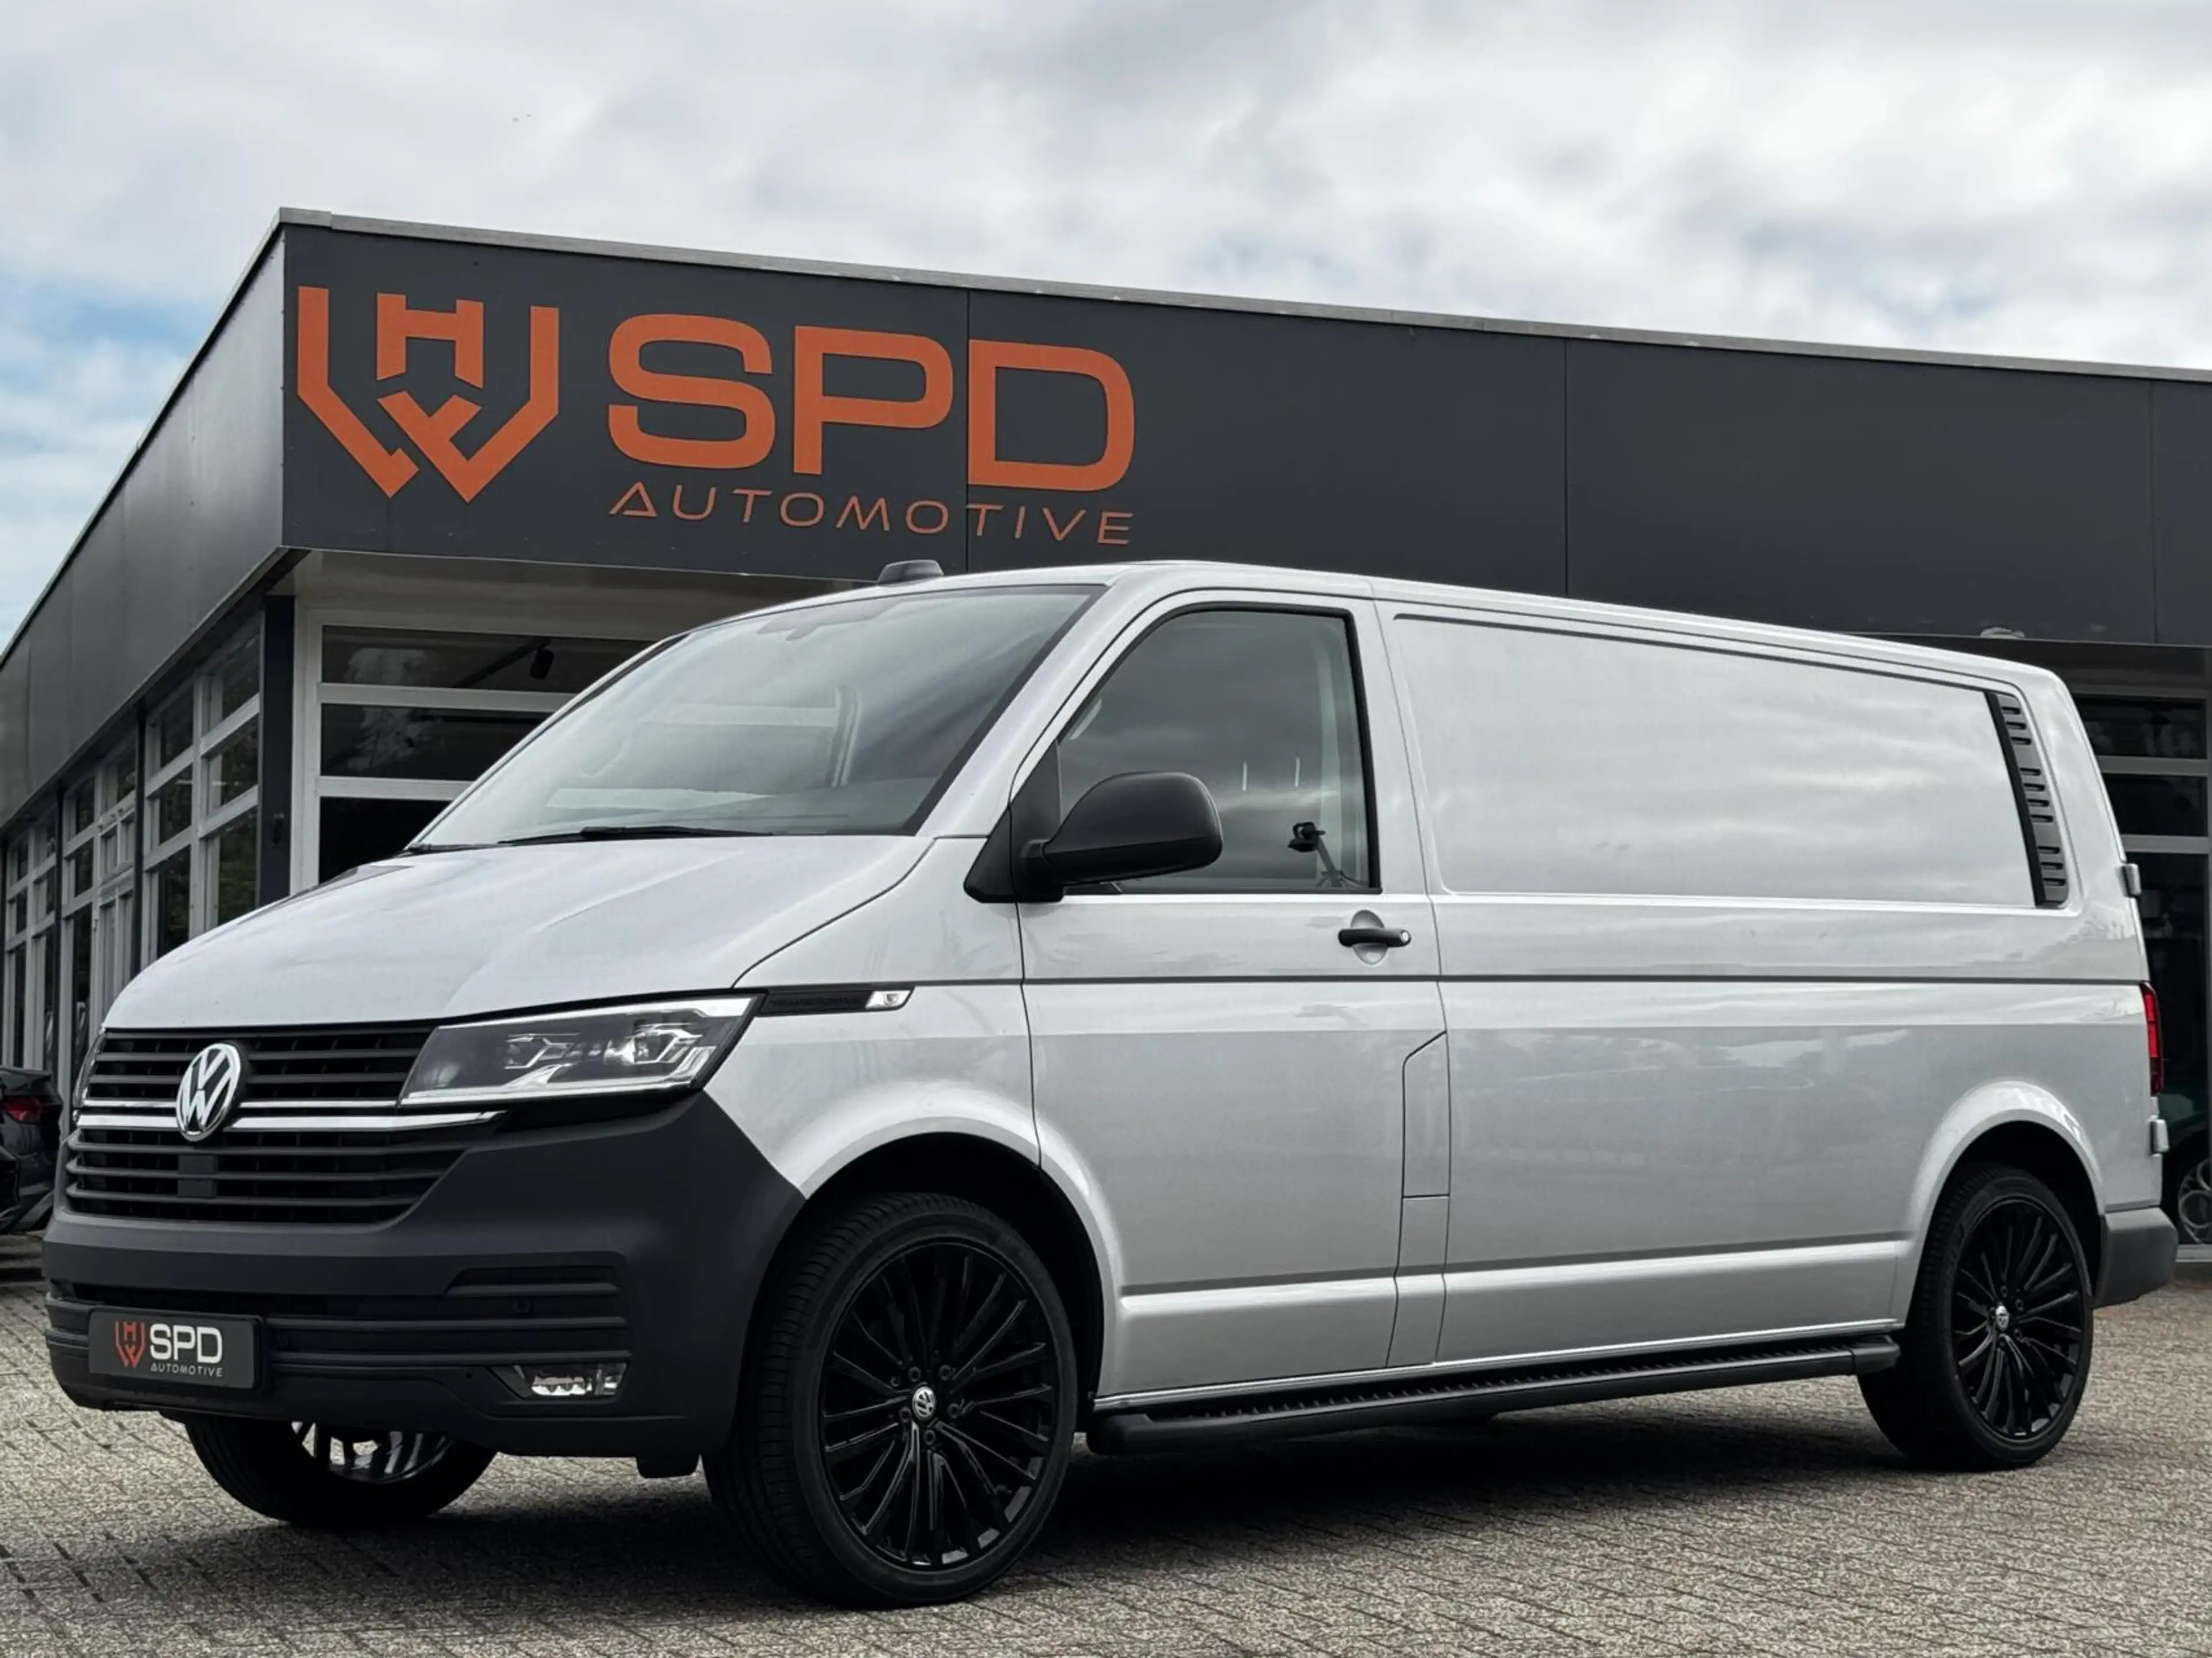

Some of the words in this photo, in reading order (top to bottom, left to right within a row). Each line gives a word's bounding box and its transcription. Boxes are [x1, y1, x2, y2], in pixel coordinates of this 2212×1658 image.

[606, 312, 1137, 493] SPD
[609, 481, 1133, 545] AUTOMOTIVE
[149, 1323, 224, 1364] SPD
[150, 1363, 224, 1378] AUTOMOTIVE
